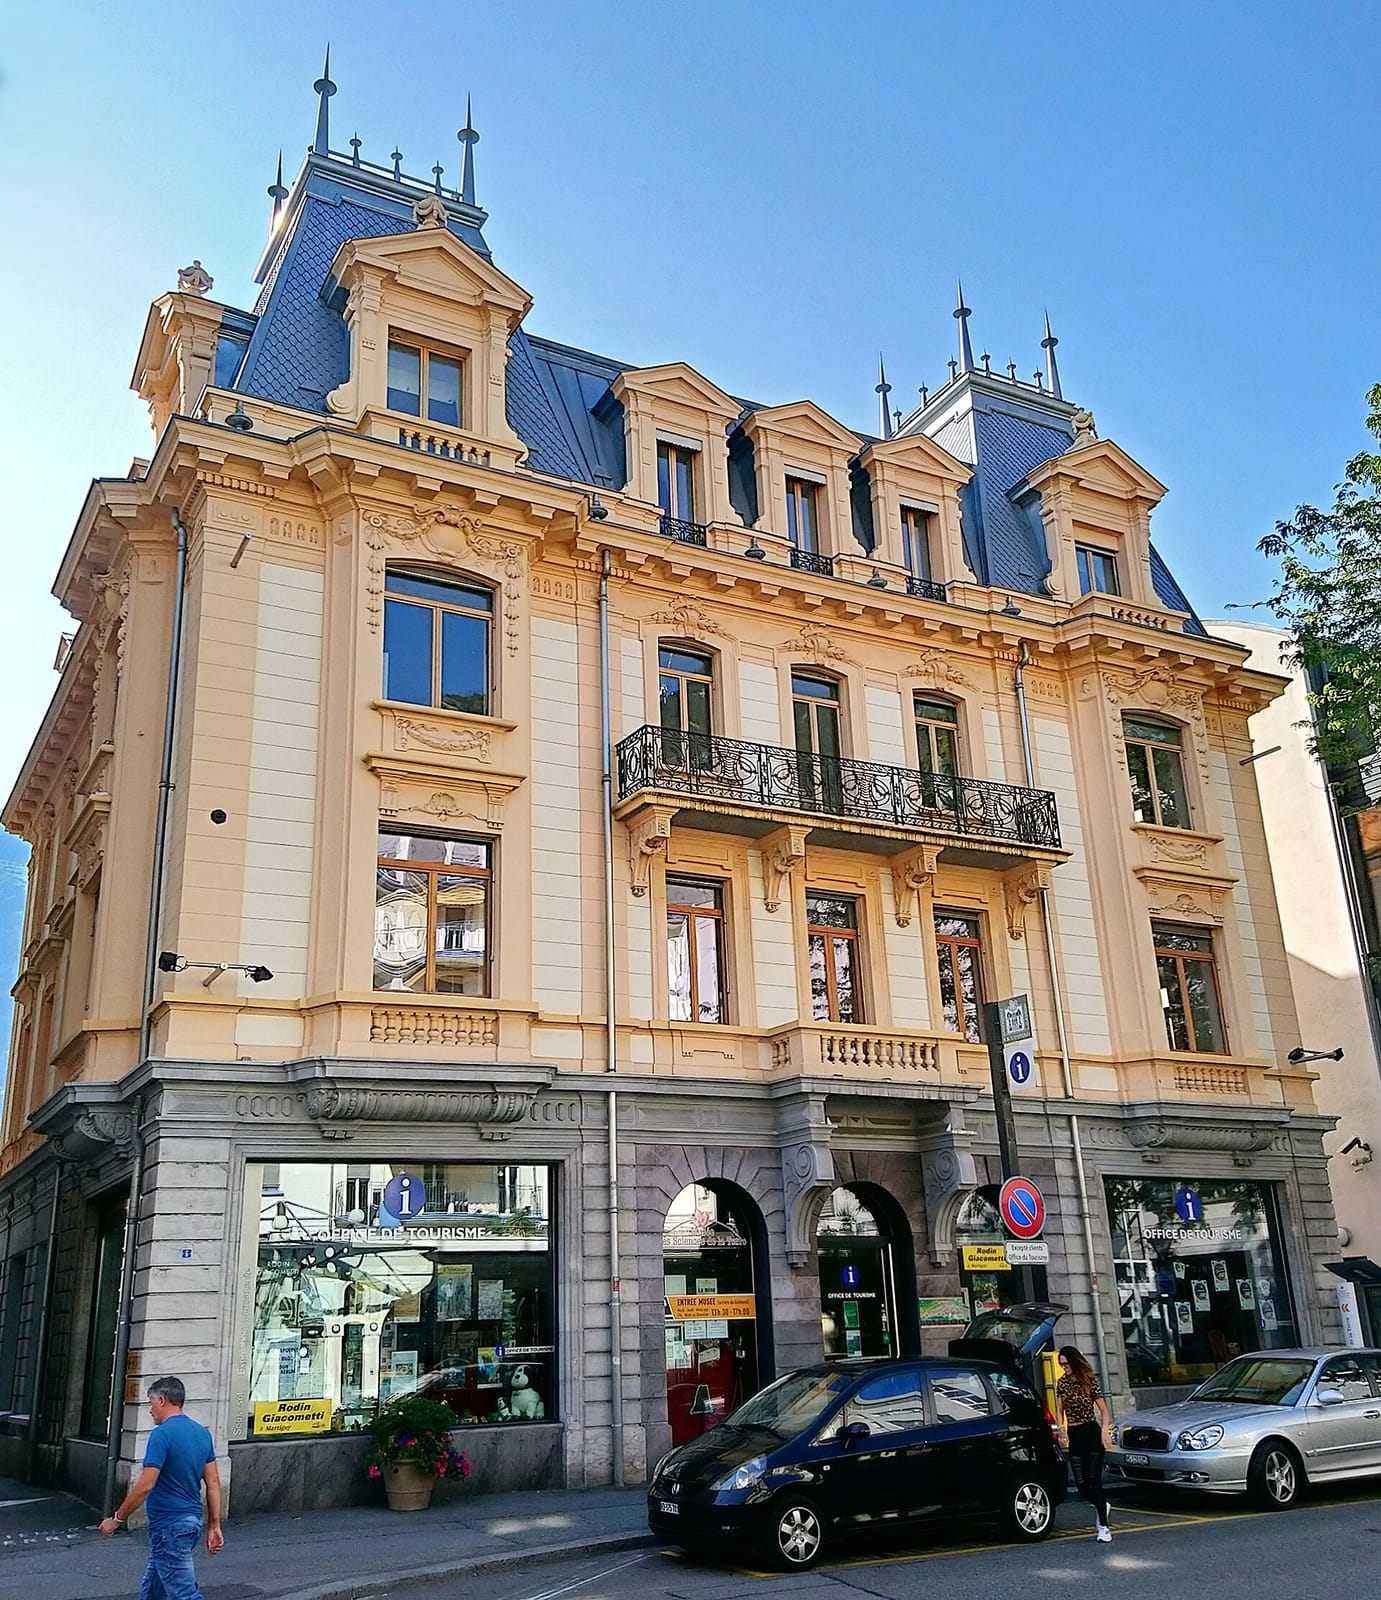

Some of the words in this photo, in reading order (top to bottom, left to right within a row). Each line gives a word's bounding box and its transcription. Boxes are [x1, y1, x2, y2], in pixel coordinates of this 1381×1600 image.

[317, 1227, 376, 1242] OFFICE
[406, 1226, 487, 1240] TOURISME
[1143, 1228, 1179, 1240] OFFICE
[1180, 1229, 1195, 1240] DE
[1195, 1229, 1242, 1240] TOURISME
[976, 1247, 997, 1255] Rodin
[278, 1402, 311, 1413] Rodin
[262, 1411, 325, 1423] Giacometti
